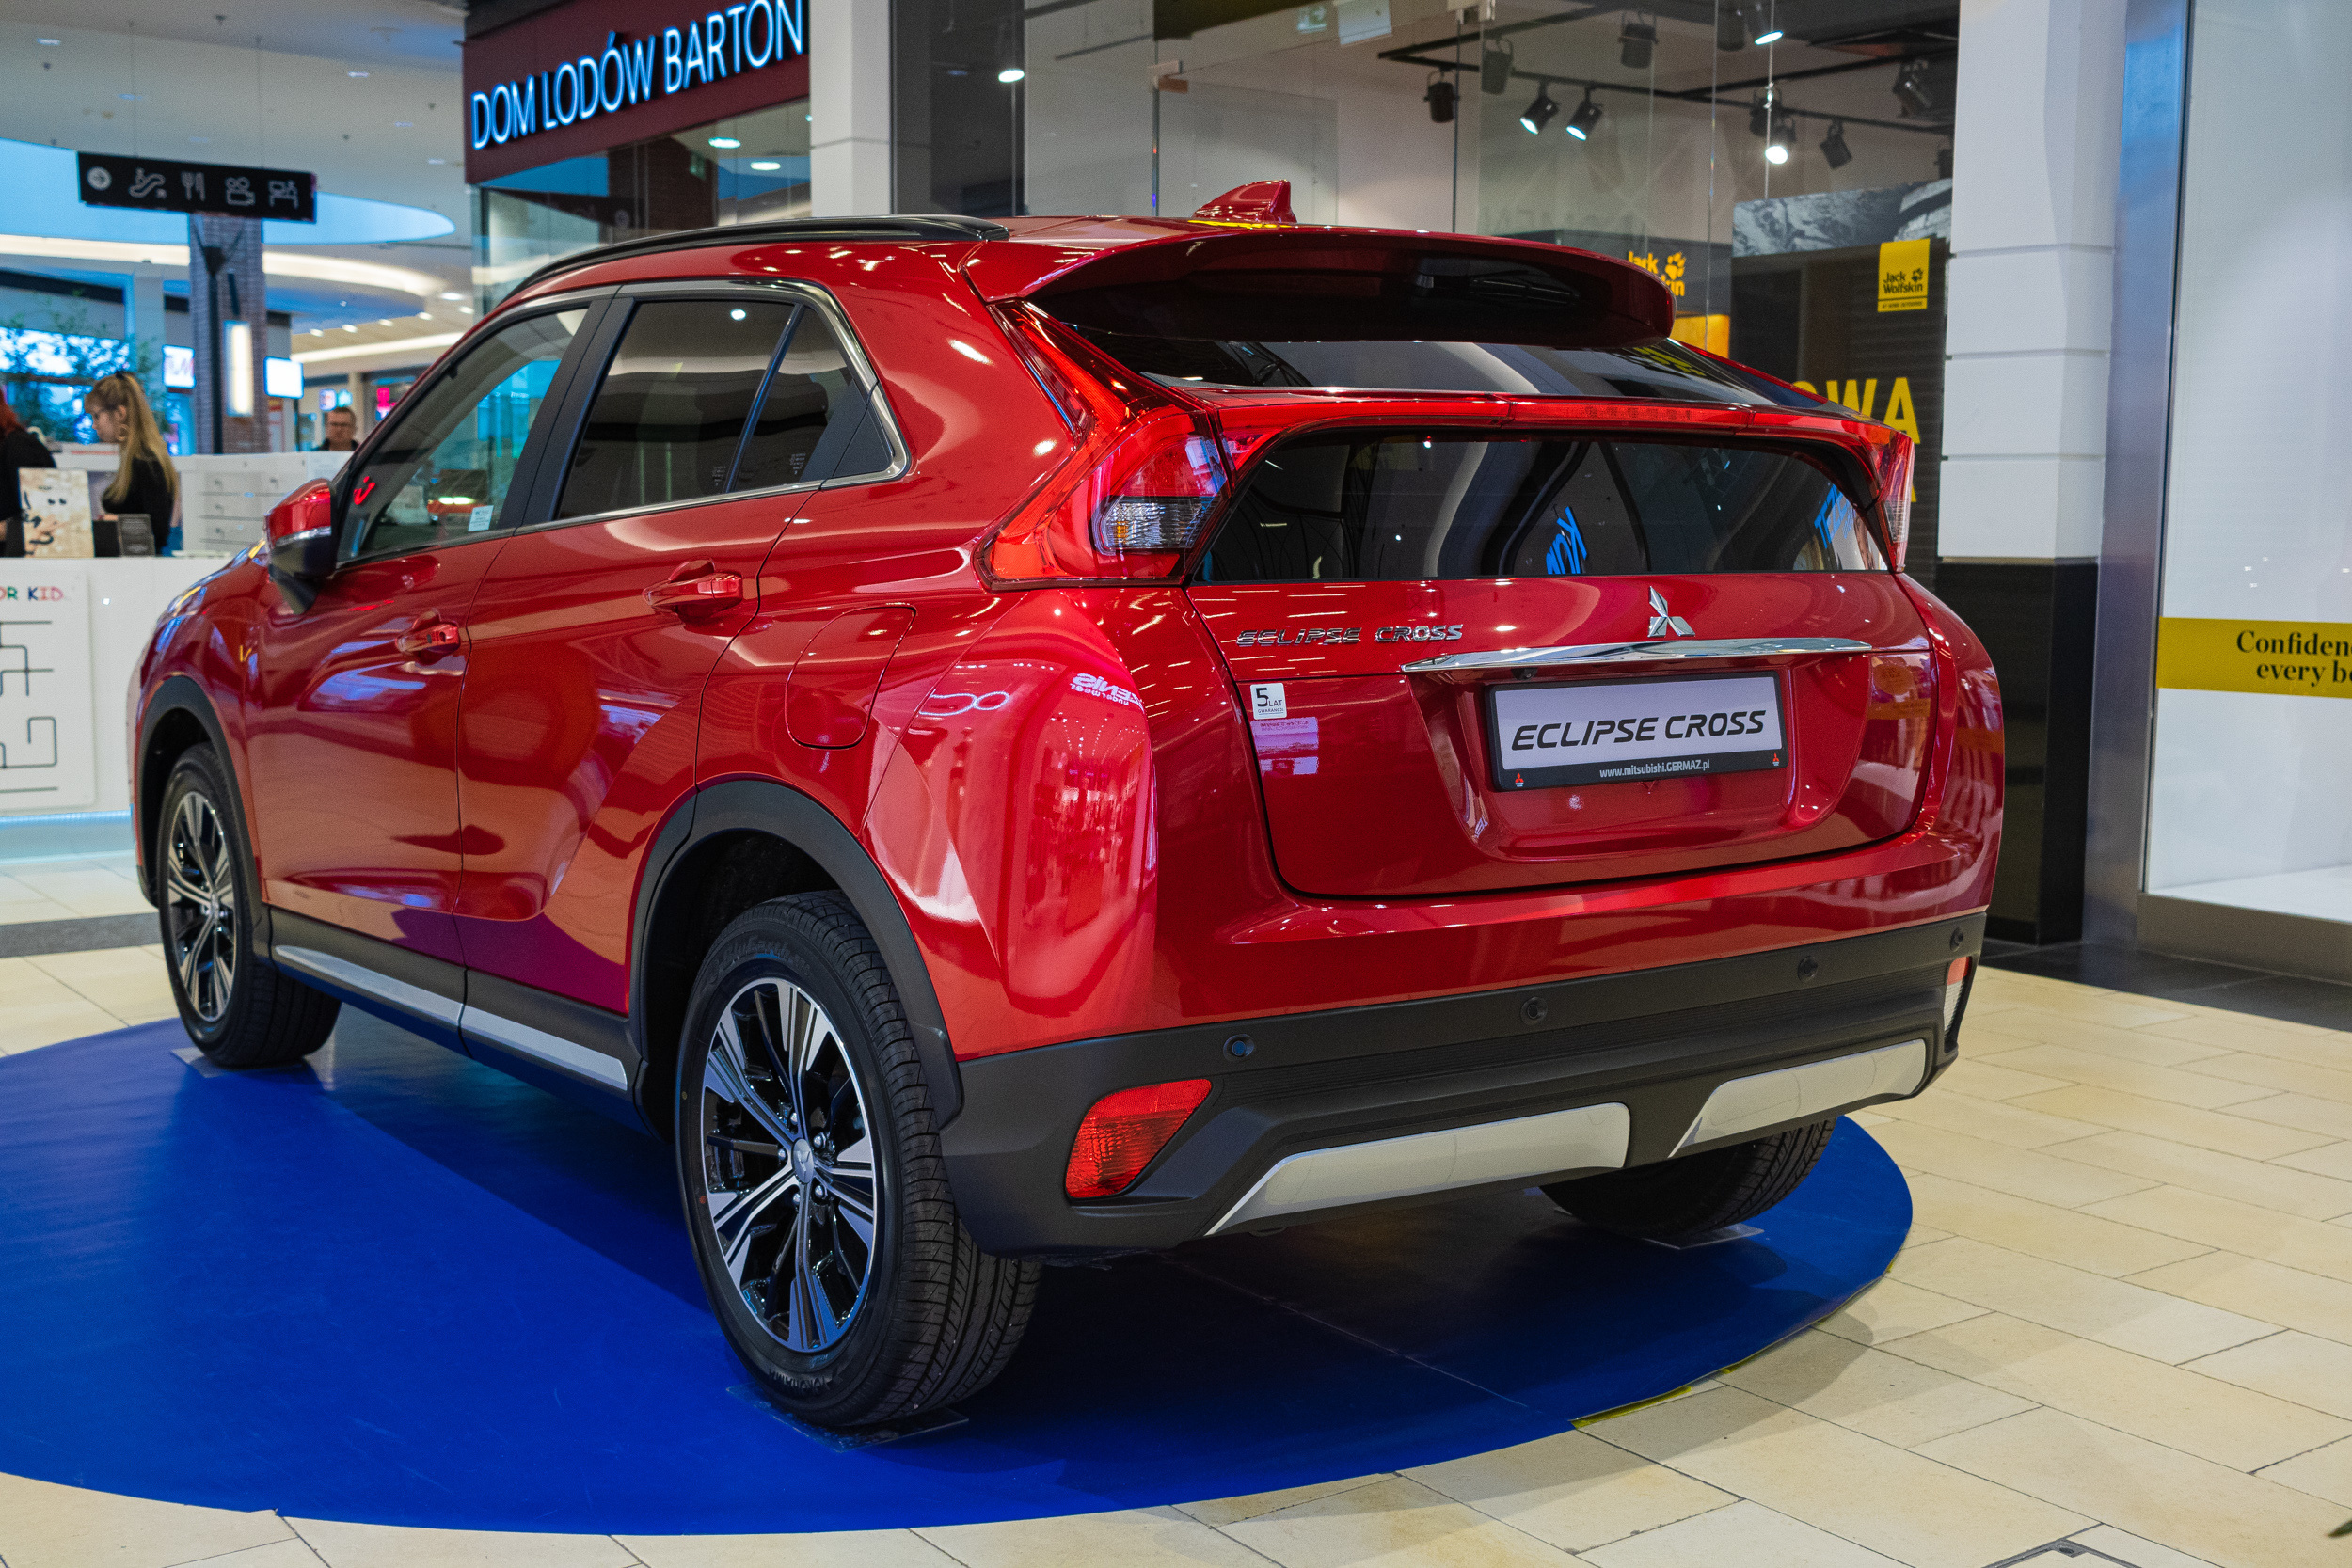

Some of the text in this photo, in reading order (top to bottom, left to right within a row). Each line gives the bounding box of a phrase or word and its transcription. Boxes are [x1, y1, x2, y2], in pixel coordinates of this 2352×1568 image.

[471, 0, 803, 150] DOM LODÓW BARTON
[1883, 271, 1906, 283] Jack
[1793, 377, 1920, 444] WA
[1236, 625, 1463, 646] ECLIPSE CROSS
[2237, 629, 2352, 657] Confiden
[2256, 662, 2326, 688] every
[1256, 687, 1283, 707] 5 LAT
[1512, 710, 1766, 751] ECLIPSE CROSS
[1599, 758, 1710, 779] www.mitsubishi.GERMAZ.pl
